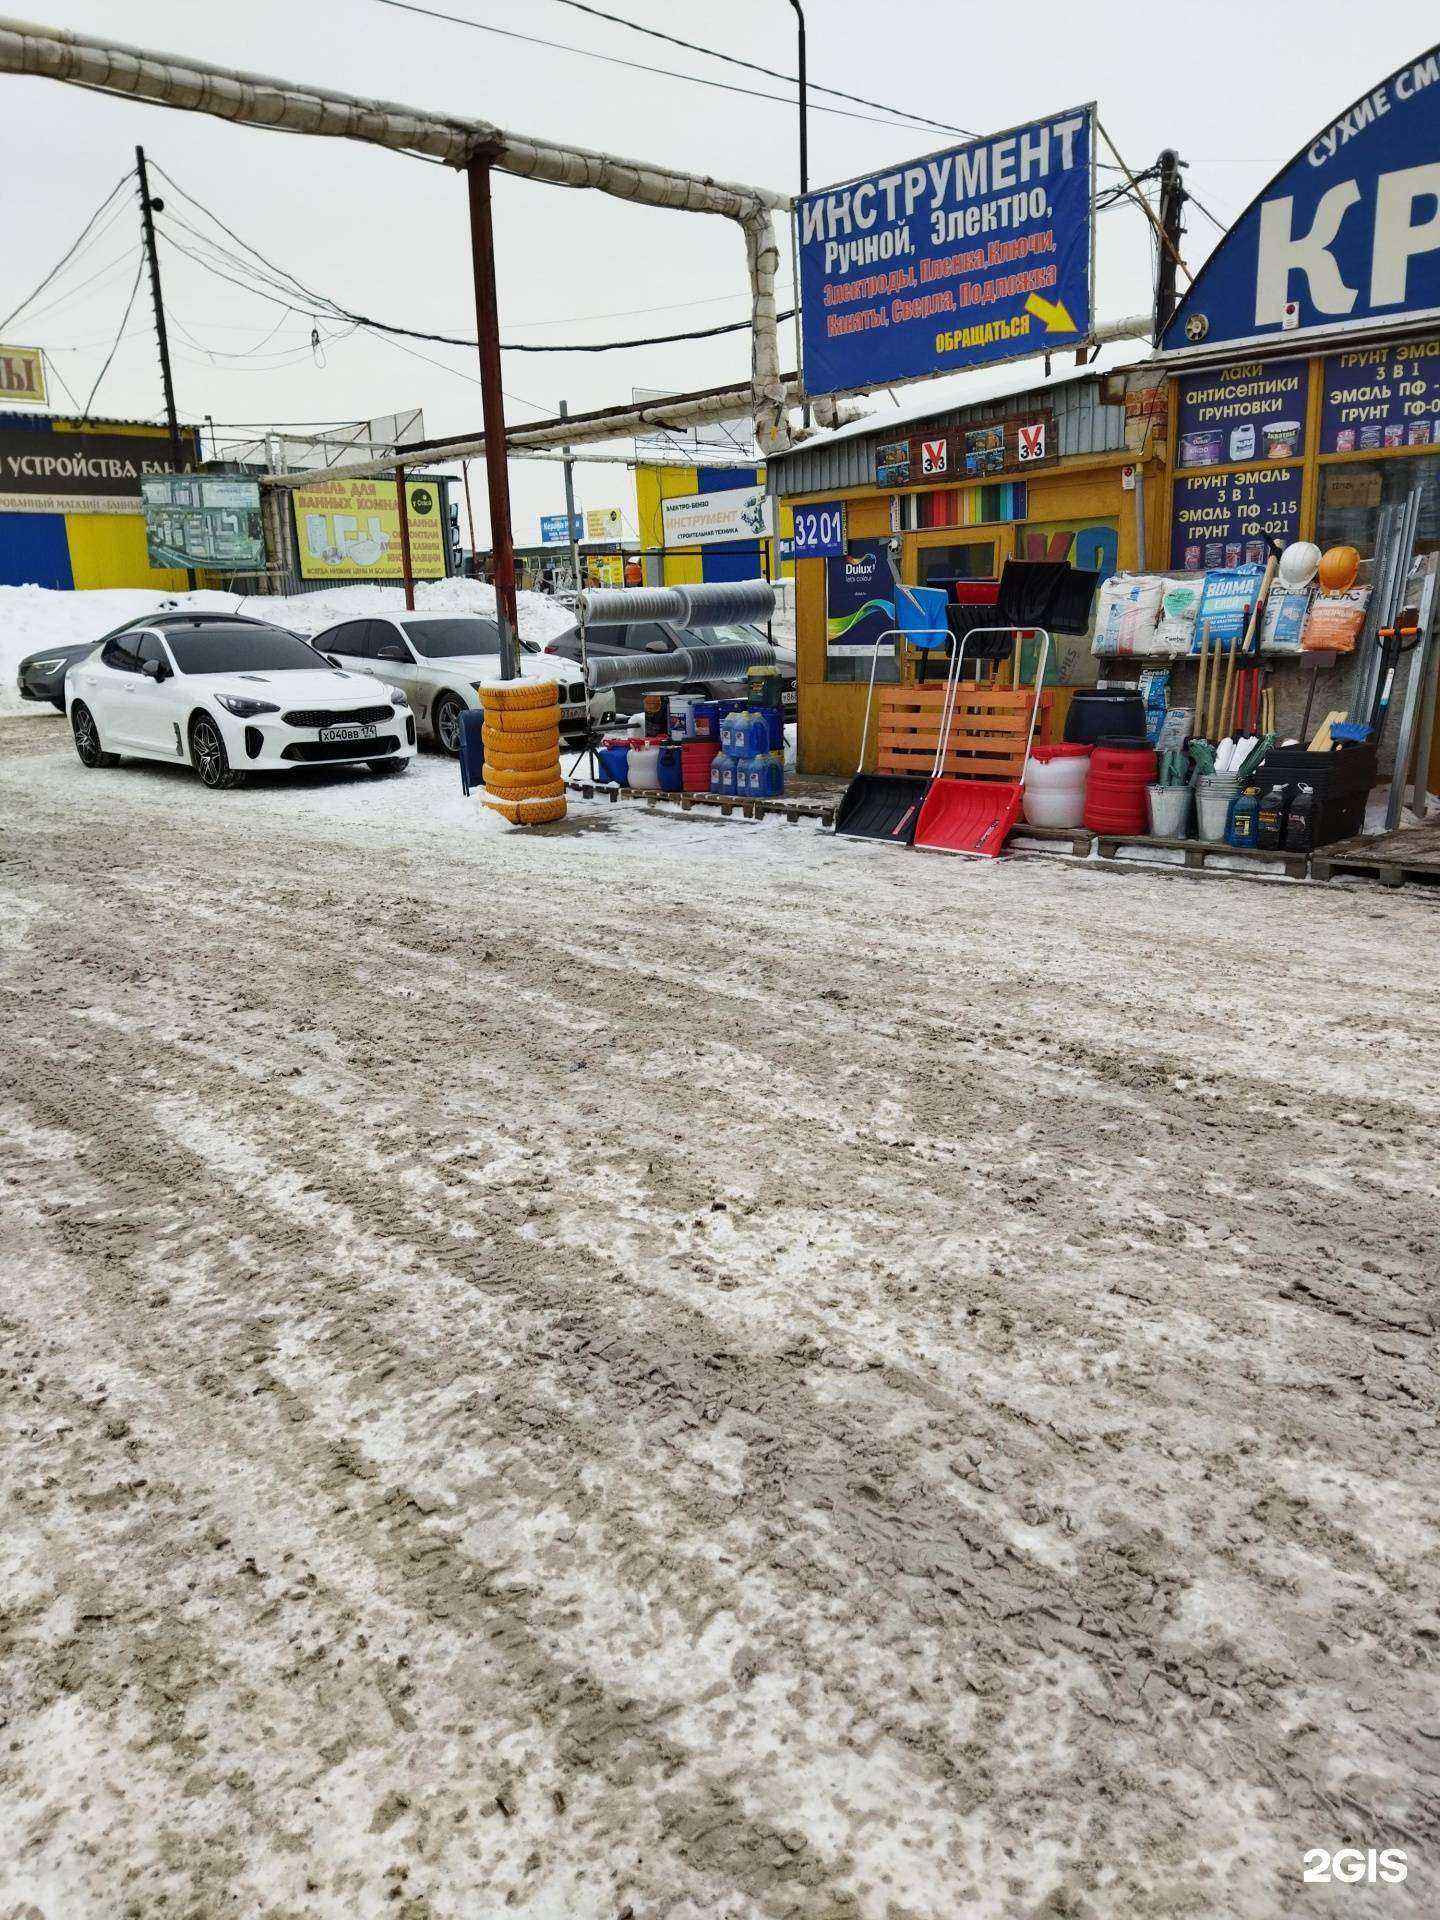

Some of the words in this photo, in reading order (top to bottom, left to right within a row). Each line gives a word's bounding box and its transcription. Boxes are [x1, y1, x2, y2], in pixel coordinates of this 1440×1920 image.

[1308, 87, 1391, 167] СУХИЕ
[1395, 53, 1440, 100] СМ
[802, 118, 1083, 245] ИНСТРУМЕНТ
[825, 218, 916, 275] Ручной,
[931, 187, 1053, 246] Электро,
[959, 265, 1057, 307] Подложка
[935, 314, 1031, 354] ОБРАЩАТЬСЯ
[1340, 348, 1389, 368] ГРУНТ
[1376, 366, 1386, 380] 3
[1393, 364, 1404, 378] В
[1399, 380, 1427, 396] ПФ
[1199, 398, 1282, 421] ГРУНТОВКИ
[1341, 404, 1390, 422] ГРУНТ
[8, 452, 138, 478] УСТРОЙСТВА
[1187, 474, 1229, 490] ГРУНТ
[1218, 490, 1226, 503] 3
[1232, 488, 1241, 501] В
[1248, 487, 1255, 500] 1
[1237, 503, 1261, 518] ПФ
[1267, 501, 1298, 515] -115
[796, 511, 842, 546] 3201
[1188, 524, 1230, 540] ГРУНТ
[1241, 520, 1289, 536] ГФ-021
[845, 563, 872, 575] Dulux
